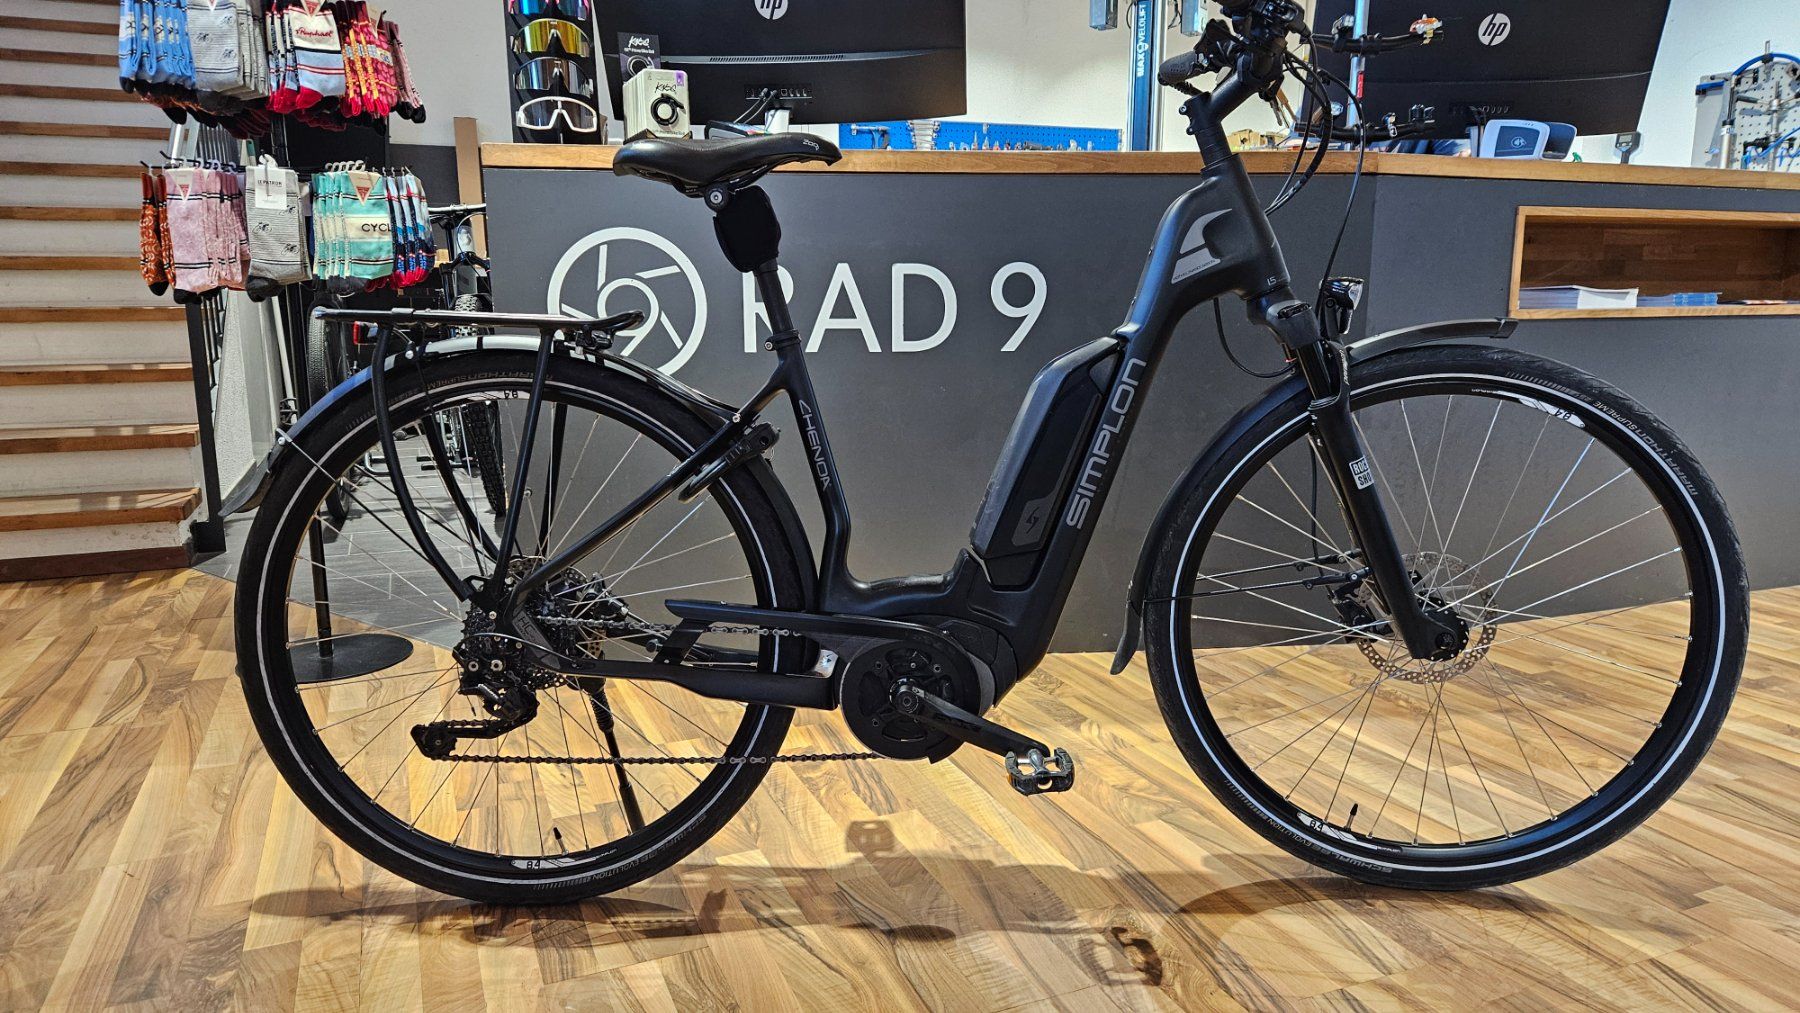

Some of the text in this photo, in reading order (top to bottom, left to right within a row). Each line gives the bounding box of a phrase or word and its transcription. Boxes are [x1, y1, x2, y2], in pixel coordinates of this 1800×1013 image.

[1481, 13, 1508, 46] hp
[742, 261, 1048, 353] RAD 9
[1593, 401, 1638, 431] SUPREME
[1066, 357, 1147, 530] SIMPLON
[1267, 818, 1313, 847] EVOLUTION
[592, 857, 640, 881] EVOLUTION
